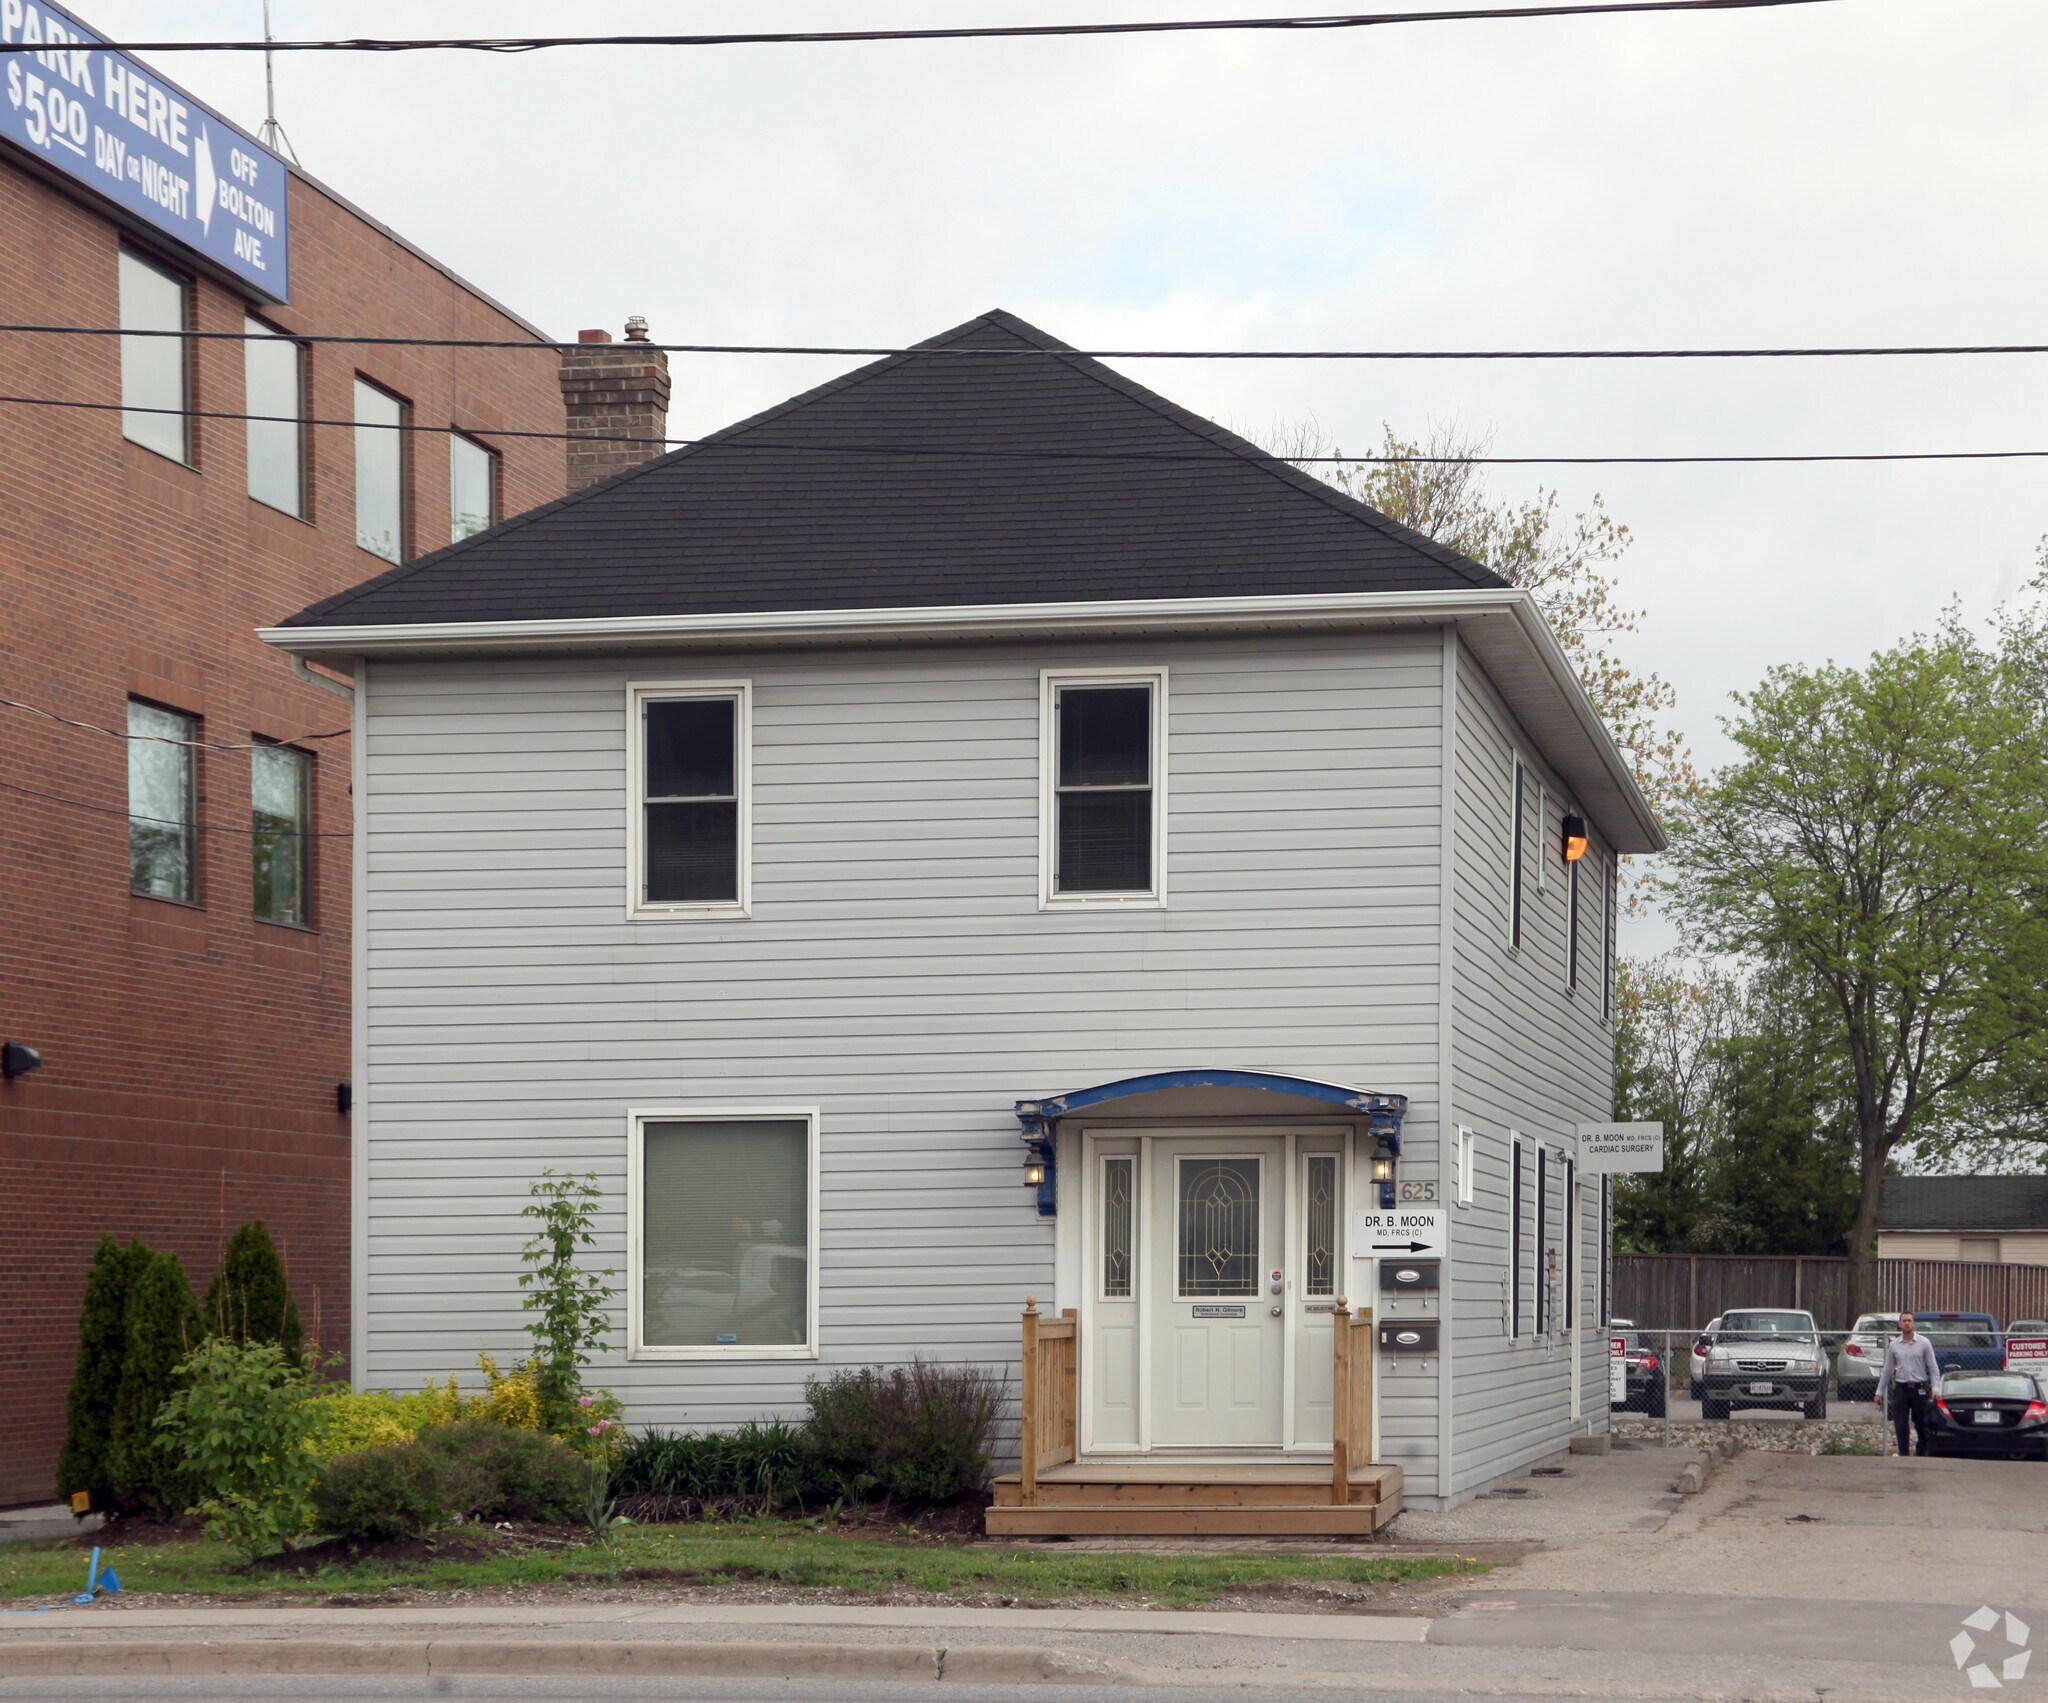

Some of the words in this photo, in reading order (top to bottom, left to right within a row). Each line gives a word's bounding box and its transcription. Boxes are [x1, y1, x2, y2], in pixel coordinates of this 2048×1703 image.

[1, 0, 96, 98] PARK
[103, 55, 188, 157] HERE
[94, 125, 127, 181] DAY
[127, 154, 141, 183] OR
[141, 154, 189, 220] NIGHT
[230, 147, 258, 187] OFF
[218, 178, 275, 238] BOLTON
[233, 228, 267, 271] AVE.
[1582, 1134, 1593, 1142] DR.
[1603, 1134, 1625, 1142] MOON
[1589, 1145, 1620, 1153] CARDIAC
[1621, 1144, 1654, 1153] SURGERY
[1402, 1183, 1435, 1200] 625
[1365, 1216, 1384, 1227] DR.
[1386, 1216, 1397, 1227] B.
[1400, 1216, 1434, 1227] MOON
[1391, 1229, 1411, 1237] FRCS
[1412, 1229, 1422, 1237] (C)
